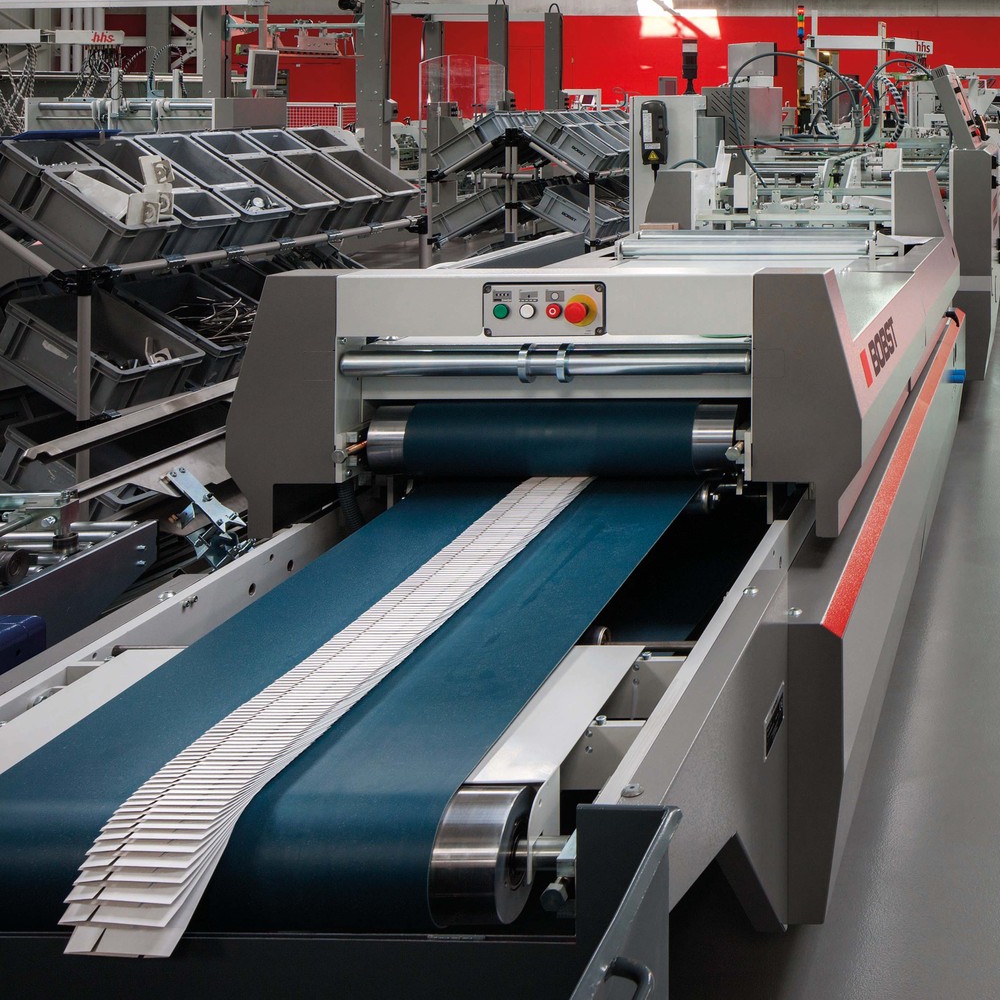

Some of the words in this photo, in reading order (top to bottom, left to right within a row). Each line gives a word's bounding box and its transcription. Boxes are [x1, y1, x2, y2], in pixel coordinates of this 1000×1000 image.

[92, 32, 115, 43] hhs
[915, 41, 931, 53] hhs
[868, 316, 898, 377] BOBST
